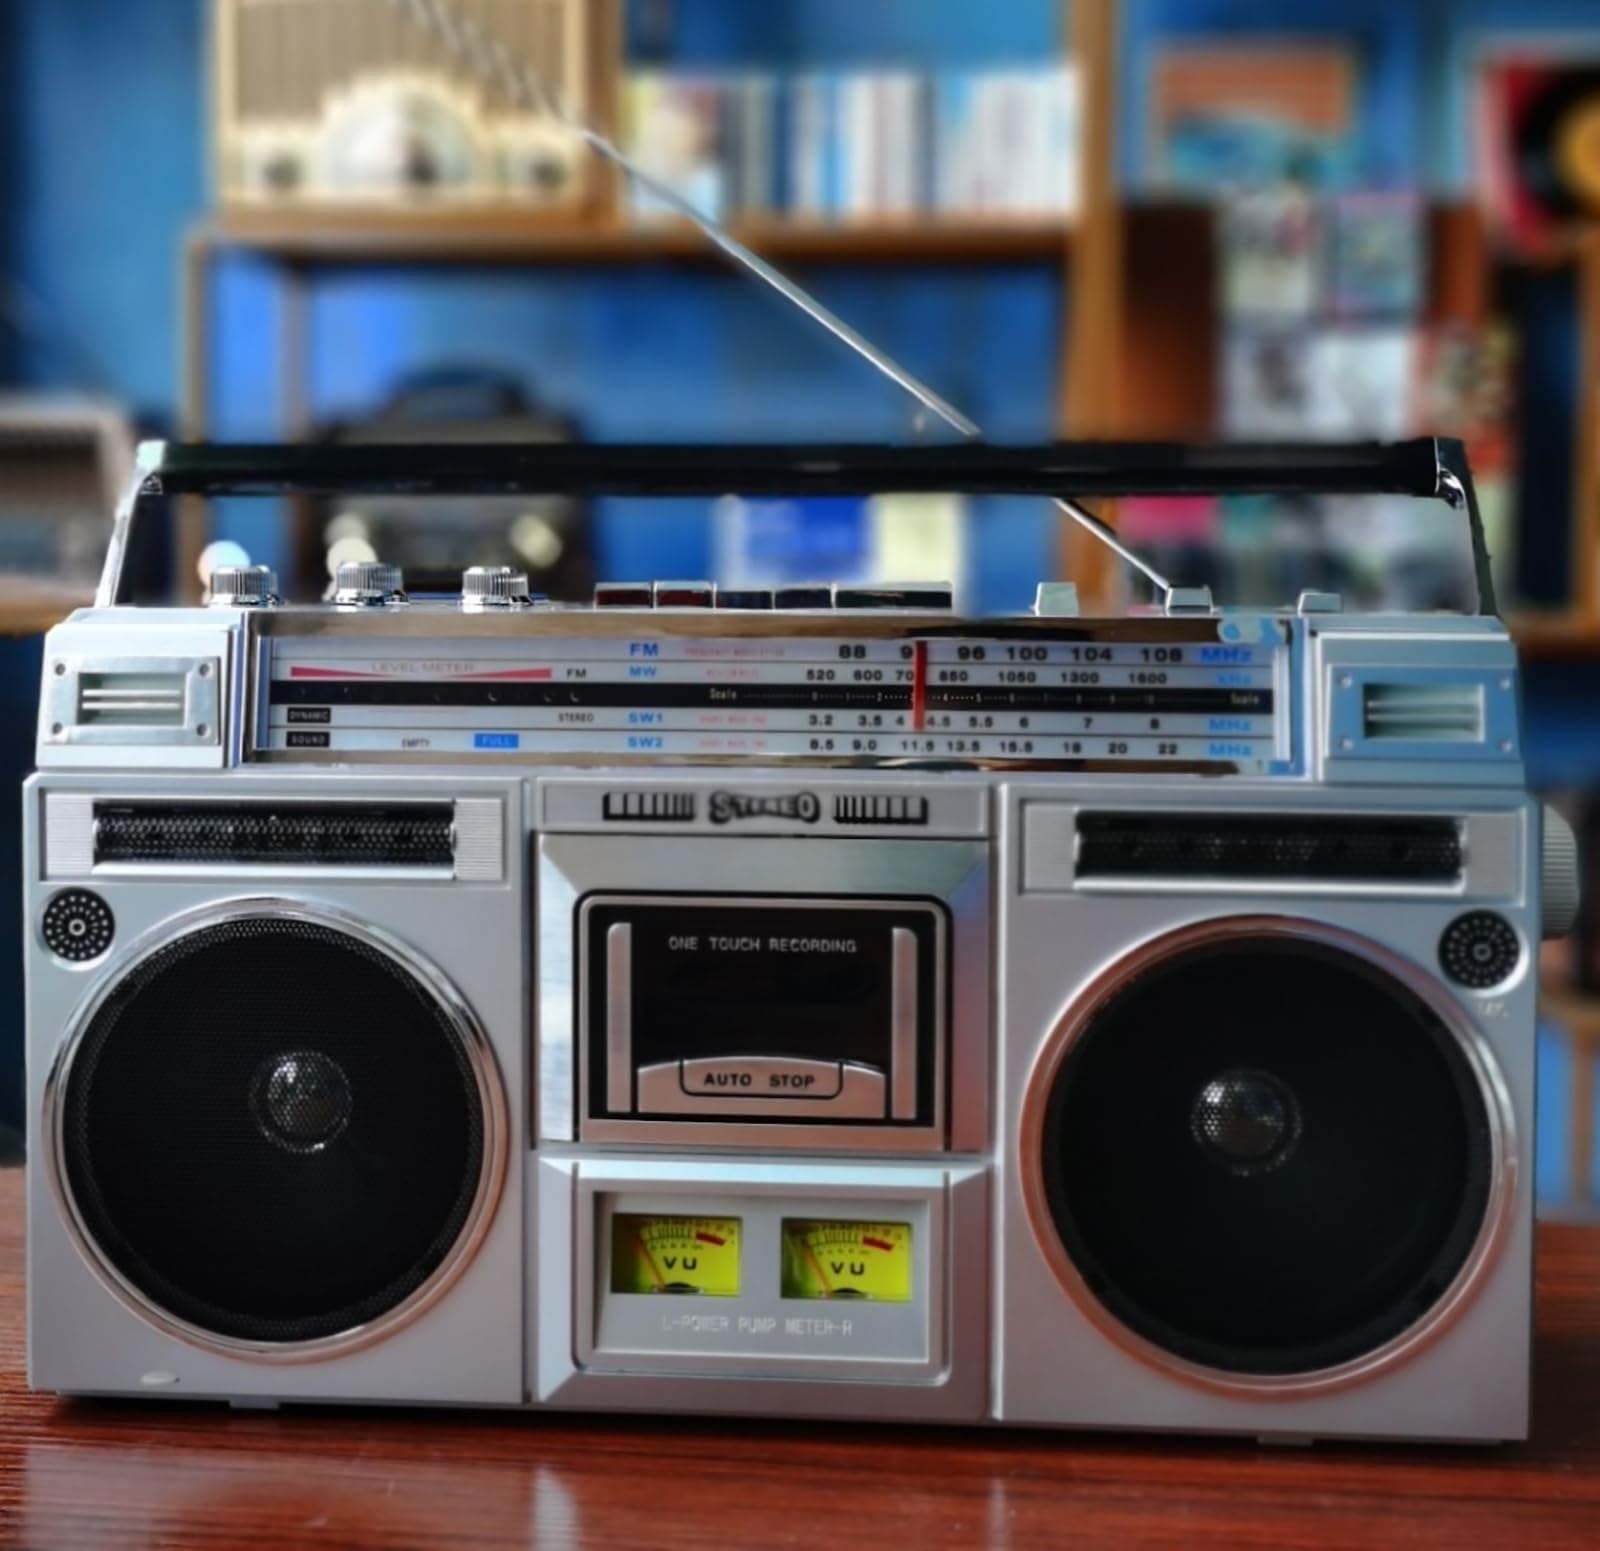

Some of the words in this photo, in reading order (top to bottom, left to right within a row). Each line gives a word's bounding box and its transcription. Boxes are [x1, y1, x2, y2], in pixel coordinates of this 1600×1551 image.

[629, 643, 659, 657] FM
[838, 645, 866, 659] 88
[957, 646, 985, 661] 96
[1006, 646, 1048, 661] 100
[1072, 647, 1113, 662] 104
[1141, 648, 1183, 663] 108
[566, 668, 587, 678] FM
[629, 666, 657, 677] MW
[806, 669, 835, 681] 520
[558, 712, 594, 723] STEREO
[628, 711, 663, 723] SW1
[1083, 717, 1093, 729] 7
[627, 736, 663, 748] SW2
[1108, 742, 1128, 754] 20
[1158, 743, 1178, 755] 22
[668, 937, 699, 951] ONE
[709, 938, 761, 952] TOUCH
[769, 939, 858, 954] RECORDING
[703, 1072, 752, 1087] AUTO
[769, 1074, 816, 1088] STOP
